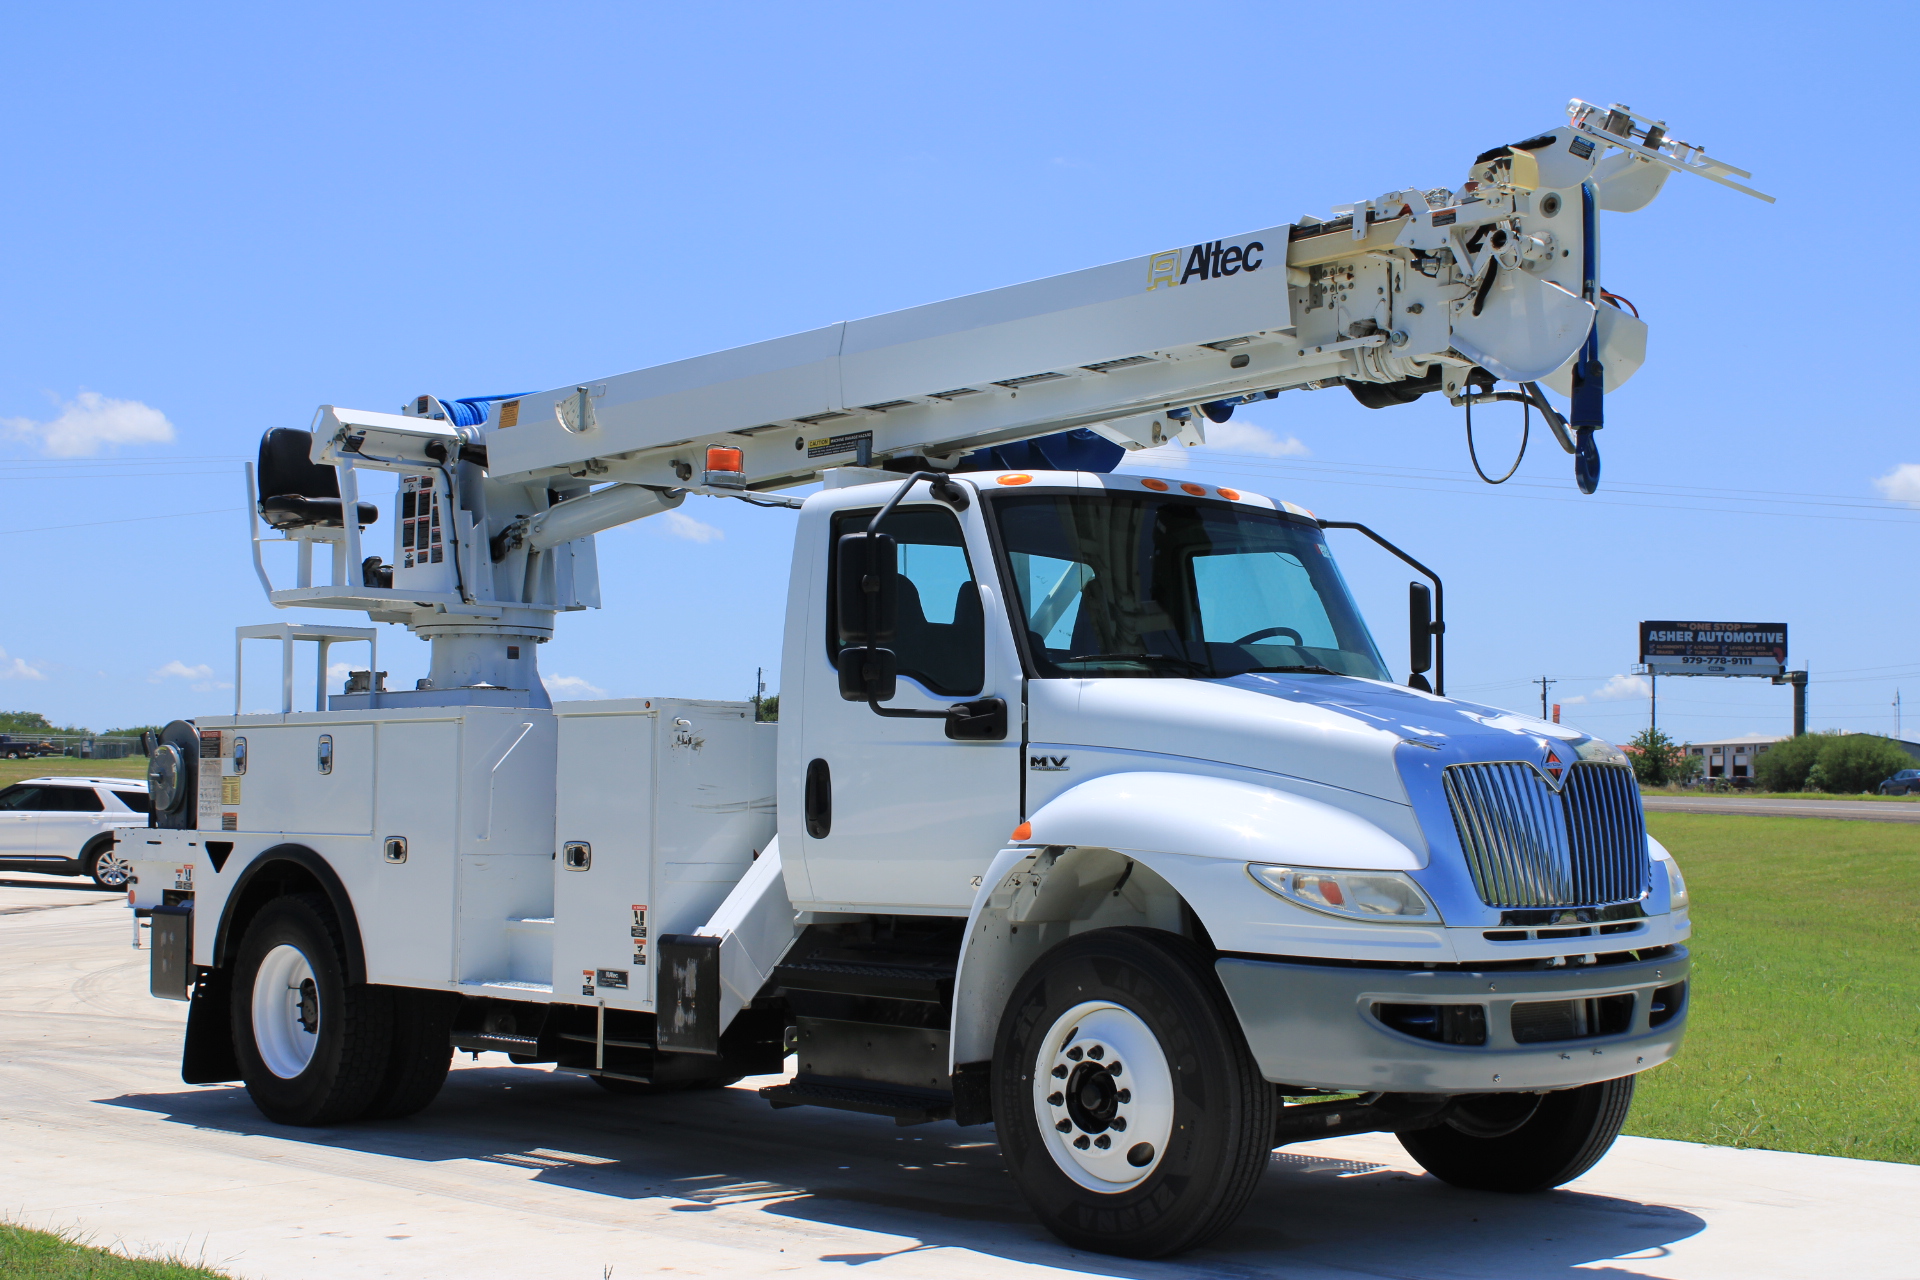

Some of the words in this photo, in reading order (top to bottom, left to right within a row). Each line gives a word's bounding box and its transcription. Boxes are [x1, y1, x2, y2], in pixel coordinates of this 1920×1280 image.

[1180, 240, 1264, 285] Altec
[809, 439, 828, 447] CAUTION
[1649, 631, 1693, 642] ASHER
[1697, 631, 1783, 643] AUTOMOTIVE
[1682, 656, 1753, 665] 979-778-9111
[1030, 755, 1070, 768] MV
